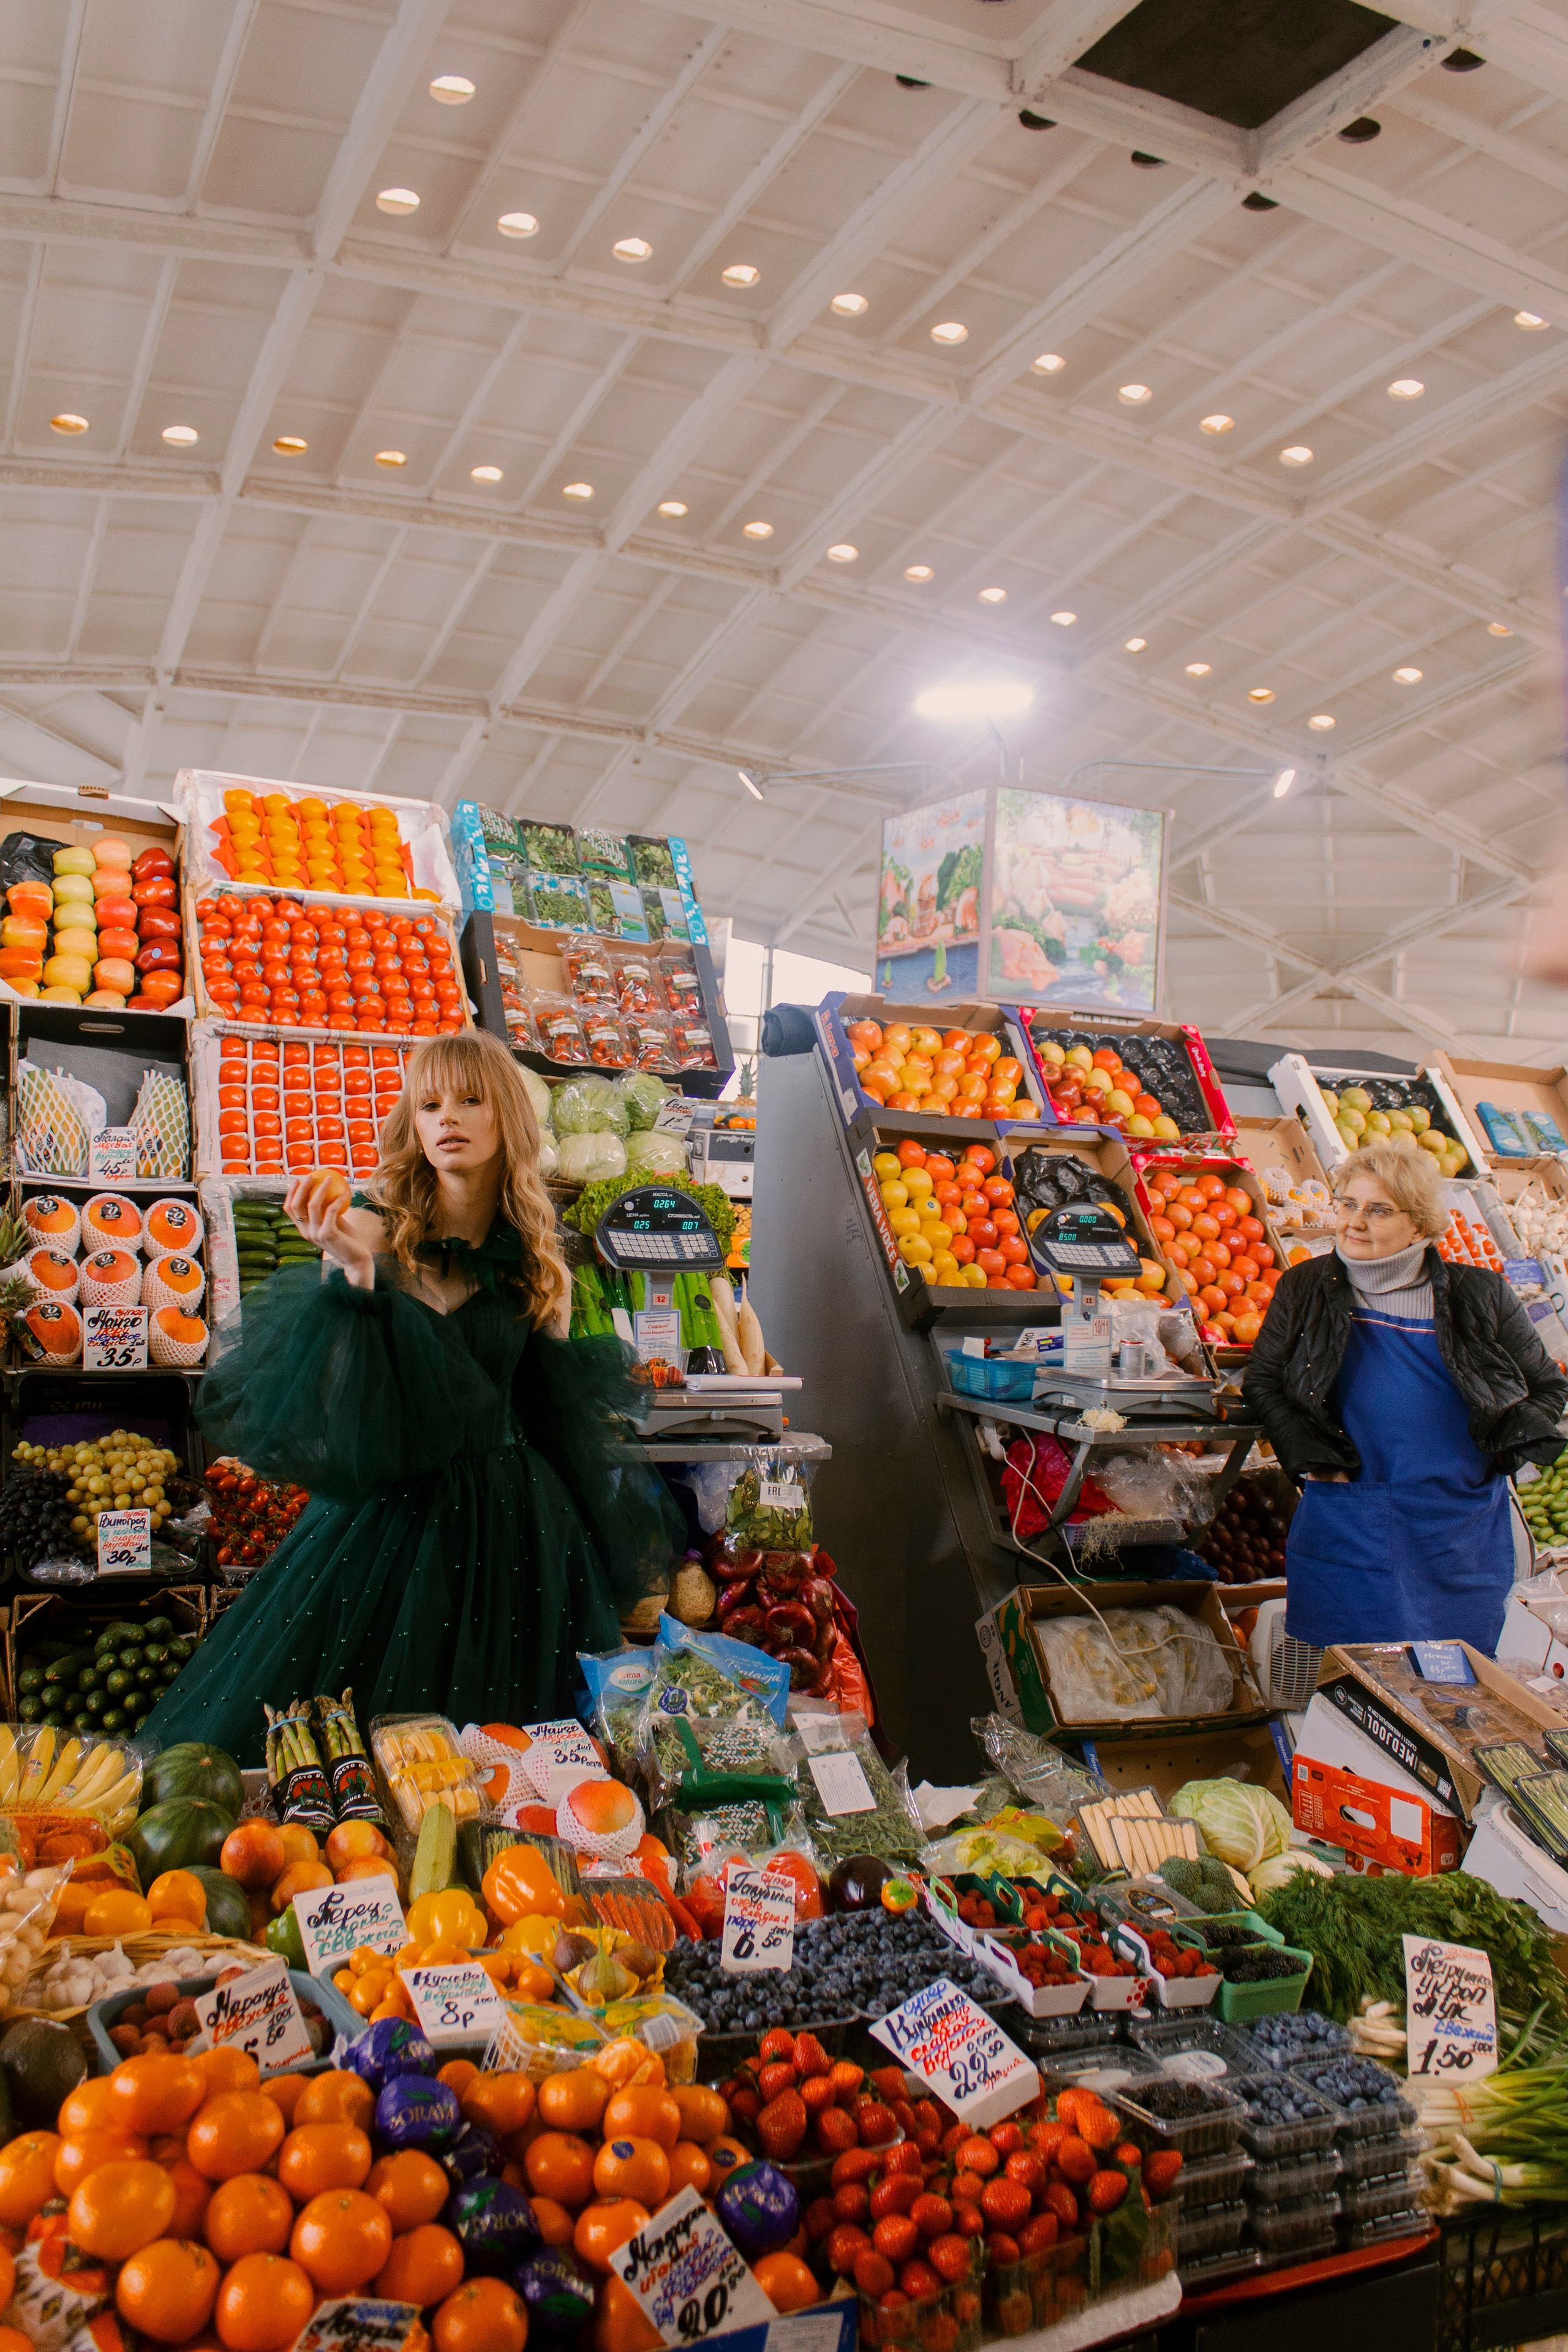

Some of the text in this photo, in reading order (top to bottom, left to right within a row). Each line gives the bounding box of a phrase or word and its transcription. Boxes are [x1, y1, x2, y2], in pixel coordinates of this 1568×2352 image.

[654, 1199, 676, 1208] 0.264
[867, 1179, 883, 1224] VERA
[633, 1220, 650, 1229] 0.25
[682, 1221, 699, 1230] 0.07
[88, 1310, 142, 1329] Манго
[99, 1514, 146, 1531] Виноград
[668, 1702, 686, 1713] NATURY
[530, 1724, 579, 1736] Манго
[1367, 1713, 1417, 1768] MEDJOOL
[1089, 1753, 1100, 1775] Plasen
[1277, 1735, 1290, 1765] Plasencia
[729, 1871, 795, 1905] Голубика
[307, 1891, 380, 1929] Перец
[1411, 1942, 1492, 1986] Петрушка
[206, 1978, 289, 2027] Маракуя
[903, 1982, 947, 2015] супер
[884, 1994, 967, 2050] Клубника
[1412, 2039, 1474, 2075] 1.50
